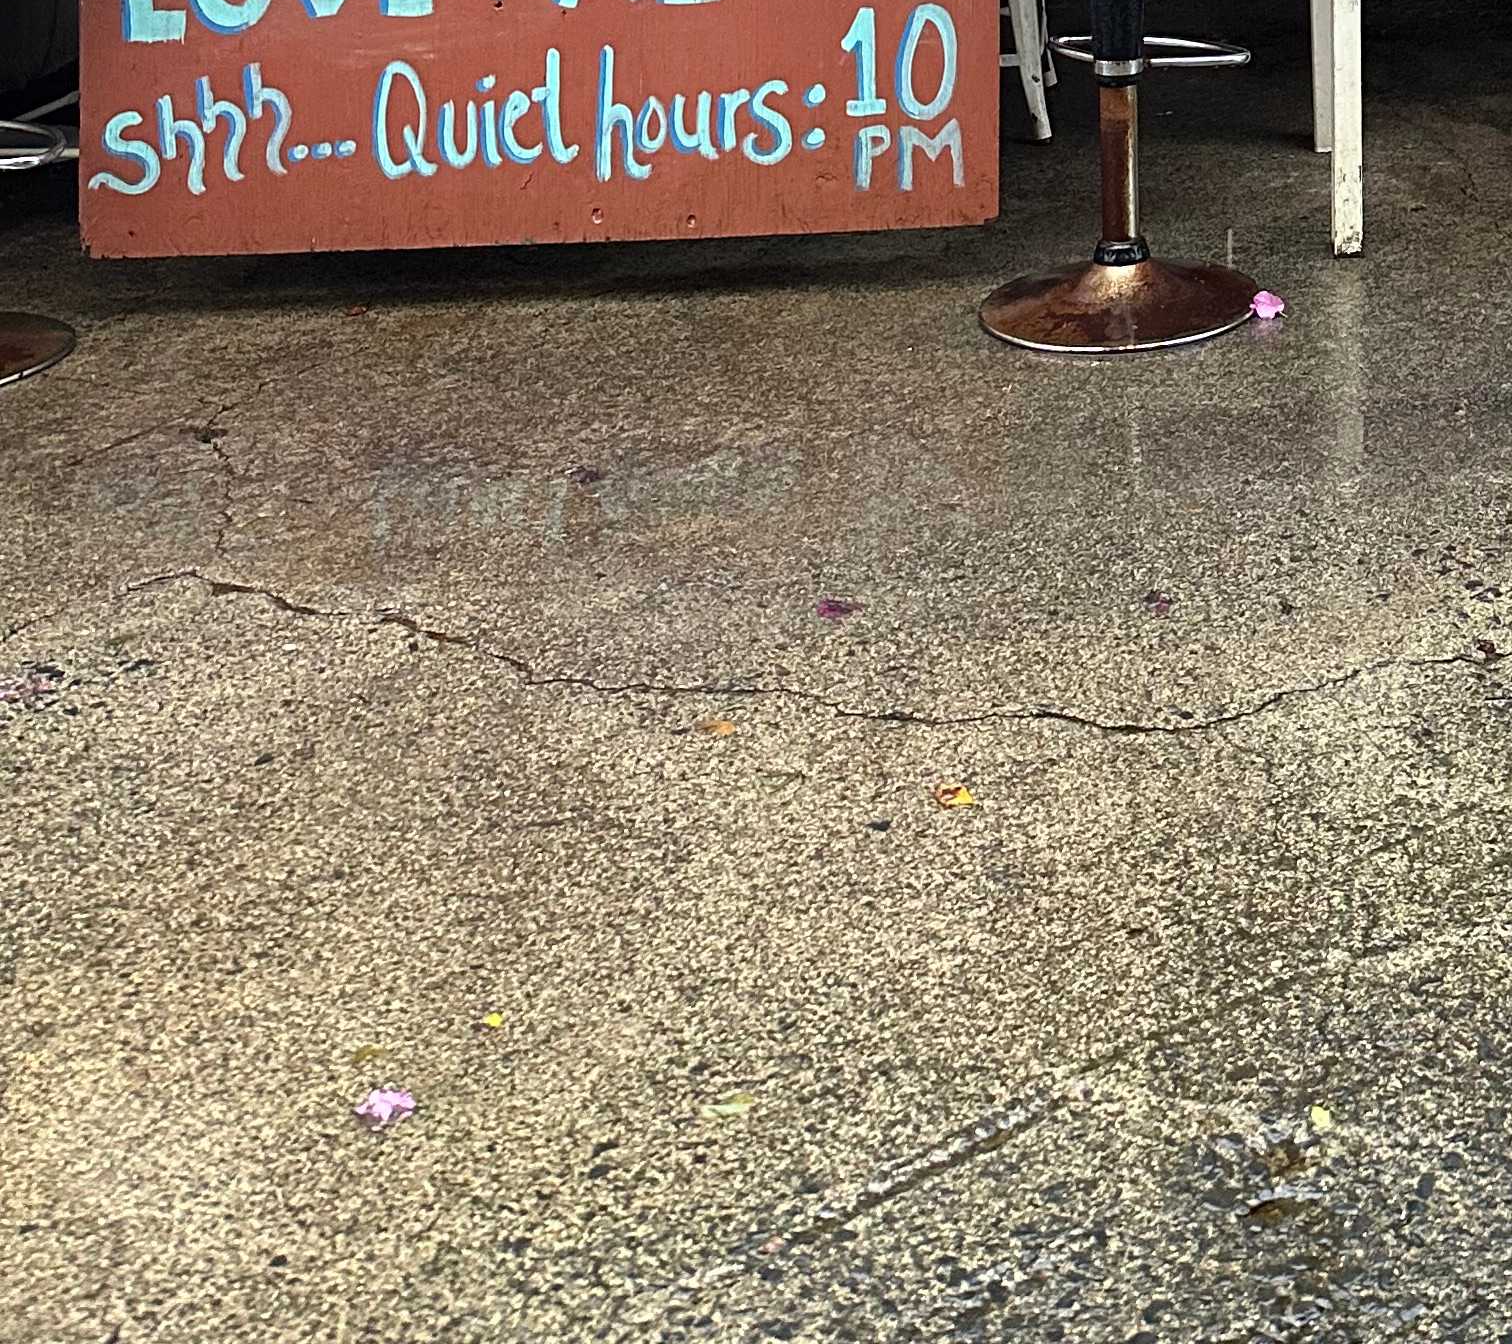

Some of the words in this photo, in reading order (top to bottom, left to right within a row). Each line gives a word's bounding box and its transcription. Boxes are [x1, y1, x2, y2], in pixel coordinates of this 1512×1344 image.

[373, 47, 579, 180] Quiet
[598, 44, 827, 182] hours:
[840, 2, 957, 120] 10
[853, 118, 966, 191] PM
